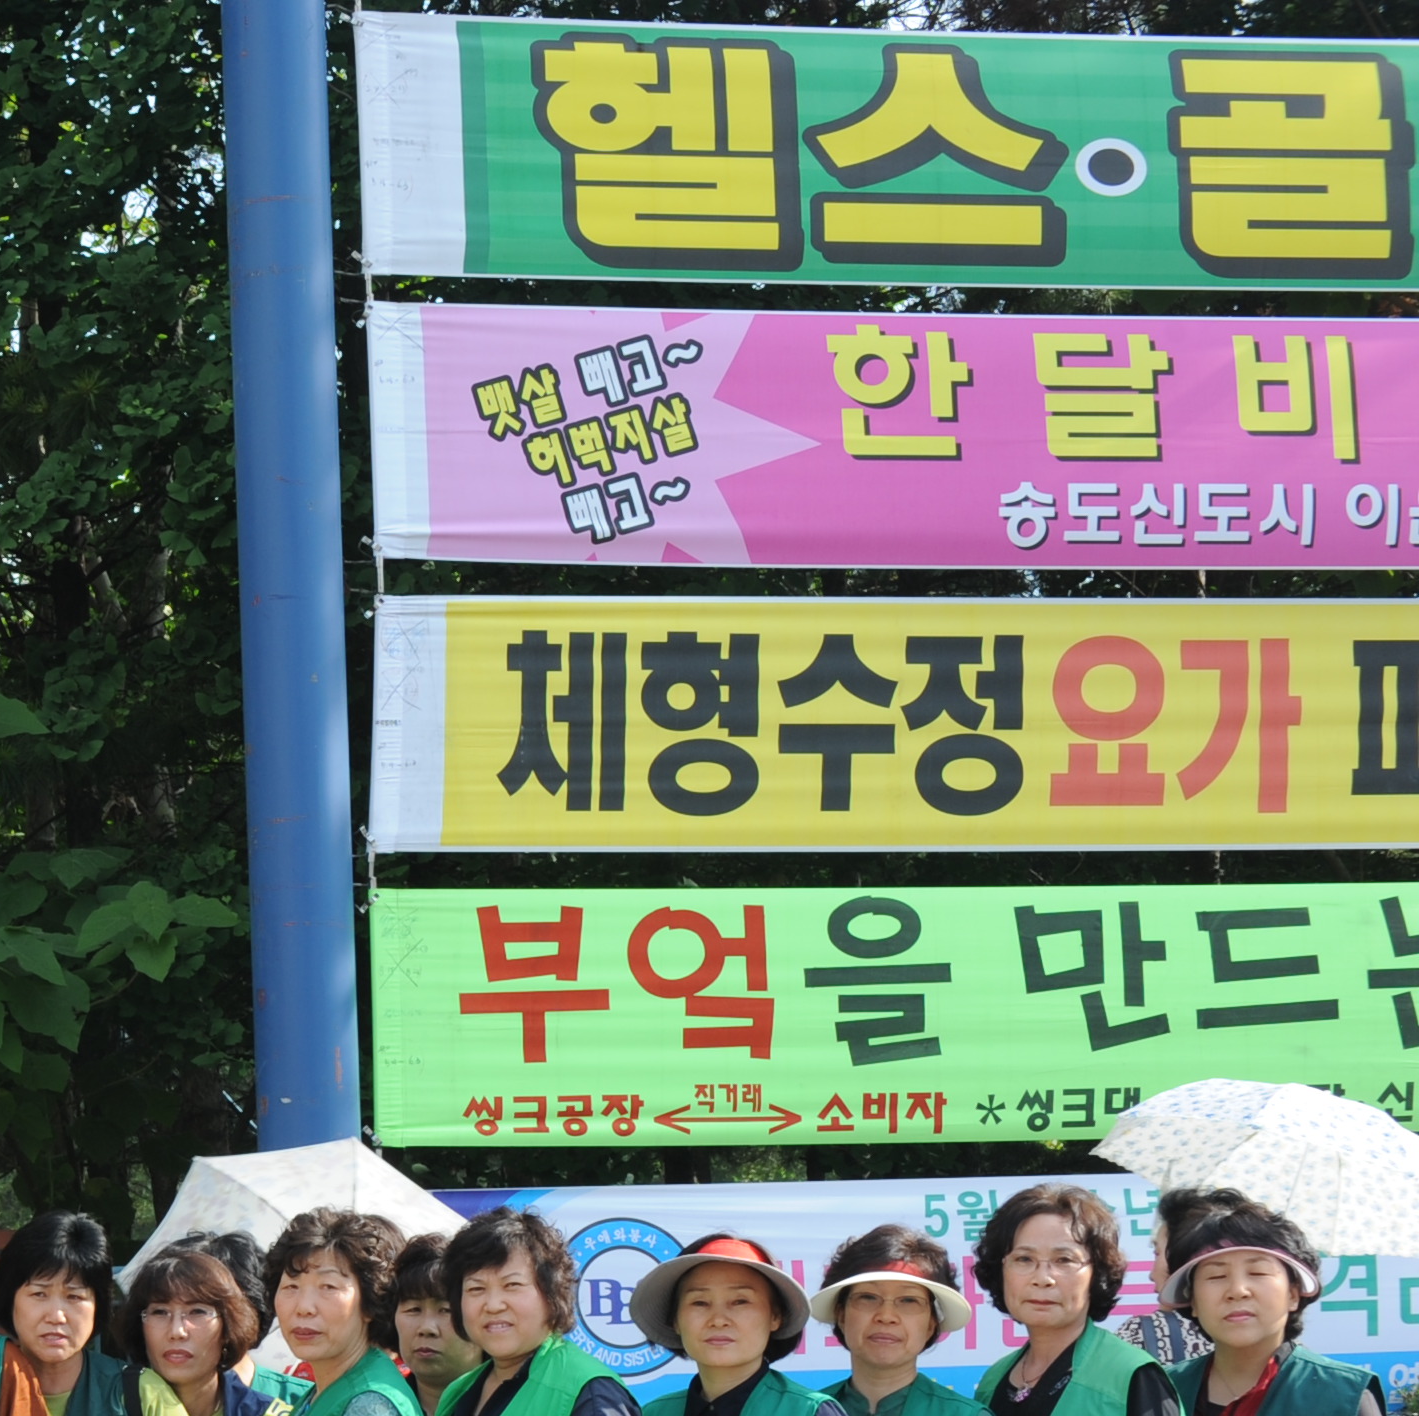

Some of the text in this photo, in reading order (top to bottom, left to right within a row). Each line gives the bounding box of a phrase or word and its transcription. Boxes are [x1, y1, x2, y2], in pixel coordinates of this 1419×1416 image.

[521, 391, 699, 488] 허벅지살
[998, 481, 1419, 549] 송도신도시 이
[459, 895, 952, 1066] 부엌을
[463, 1094, 645, 1138] 씽크공장
[816, 1091, 948, 1135] 소비자
[694, 1083, 763, 1113] 직거래
